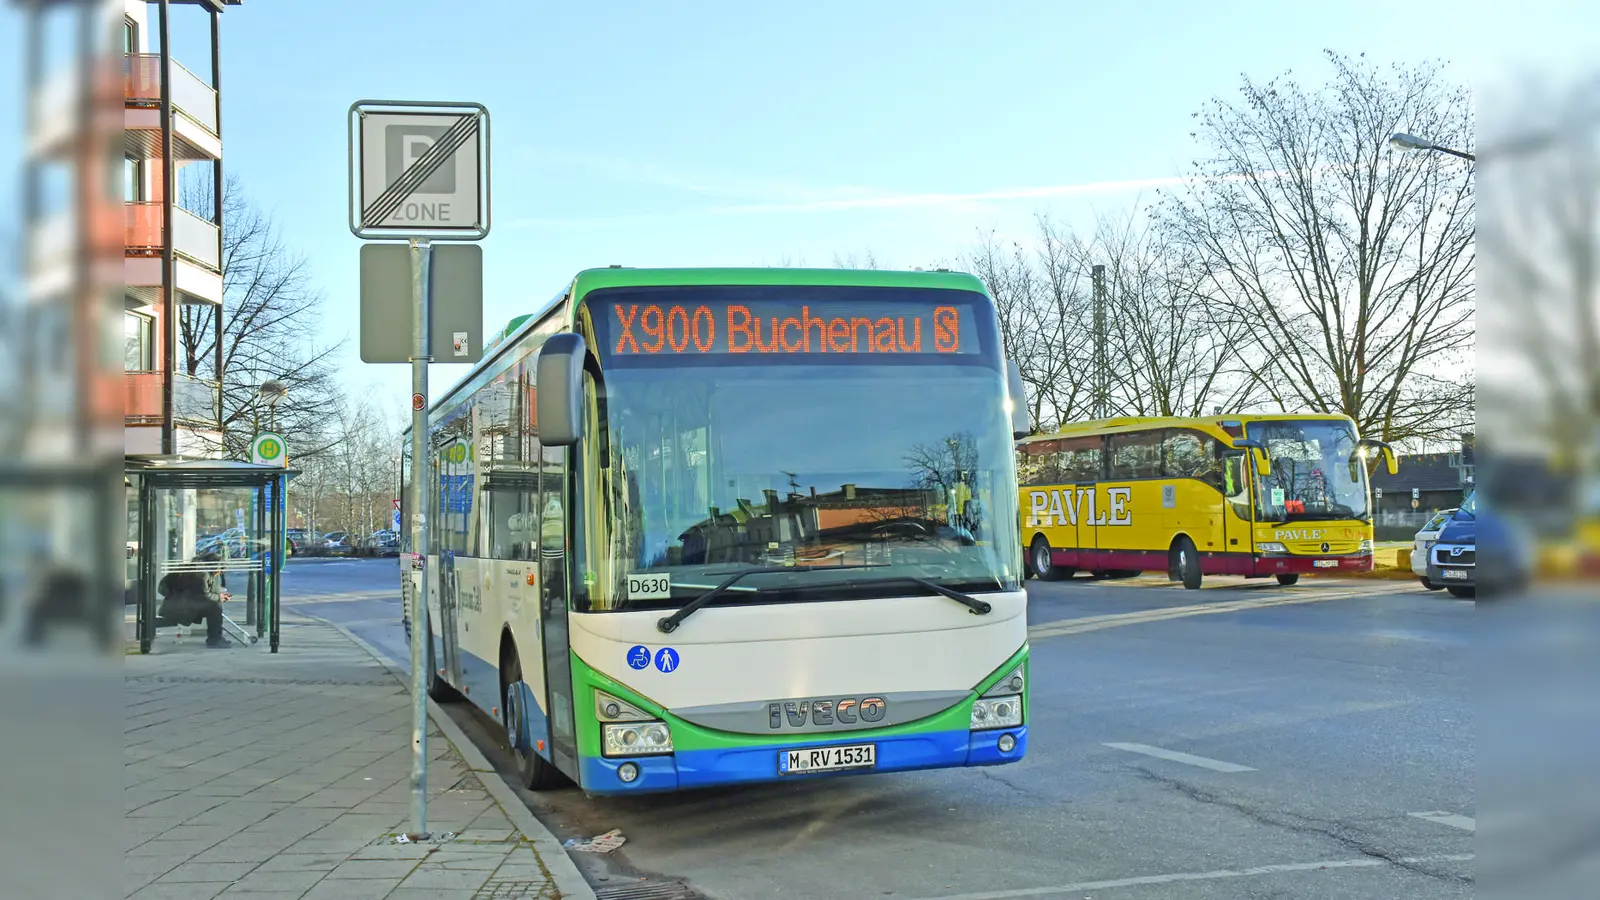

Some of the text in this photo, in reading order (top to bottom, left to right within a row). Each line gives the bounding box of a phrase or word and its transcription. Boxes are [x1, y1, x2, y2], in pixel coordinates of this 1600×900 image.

[392, 202, 451, 221] ZONE
[614, 303, 959, 354] X900 Buchenau S
[263, 443, 275, 455] H
[1029, 486, 1132, 527] PAVLE
[1274, 529, 1322, 541] PAVLE
[629, 579, 669, 594] D630
[768, 696, 887, 729] IVECO
[789, 752, 800, 769] M
[810, 749, 831, 767] RV
[834, 746, 873, 766] 1531
